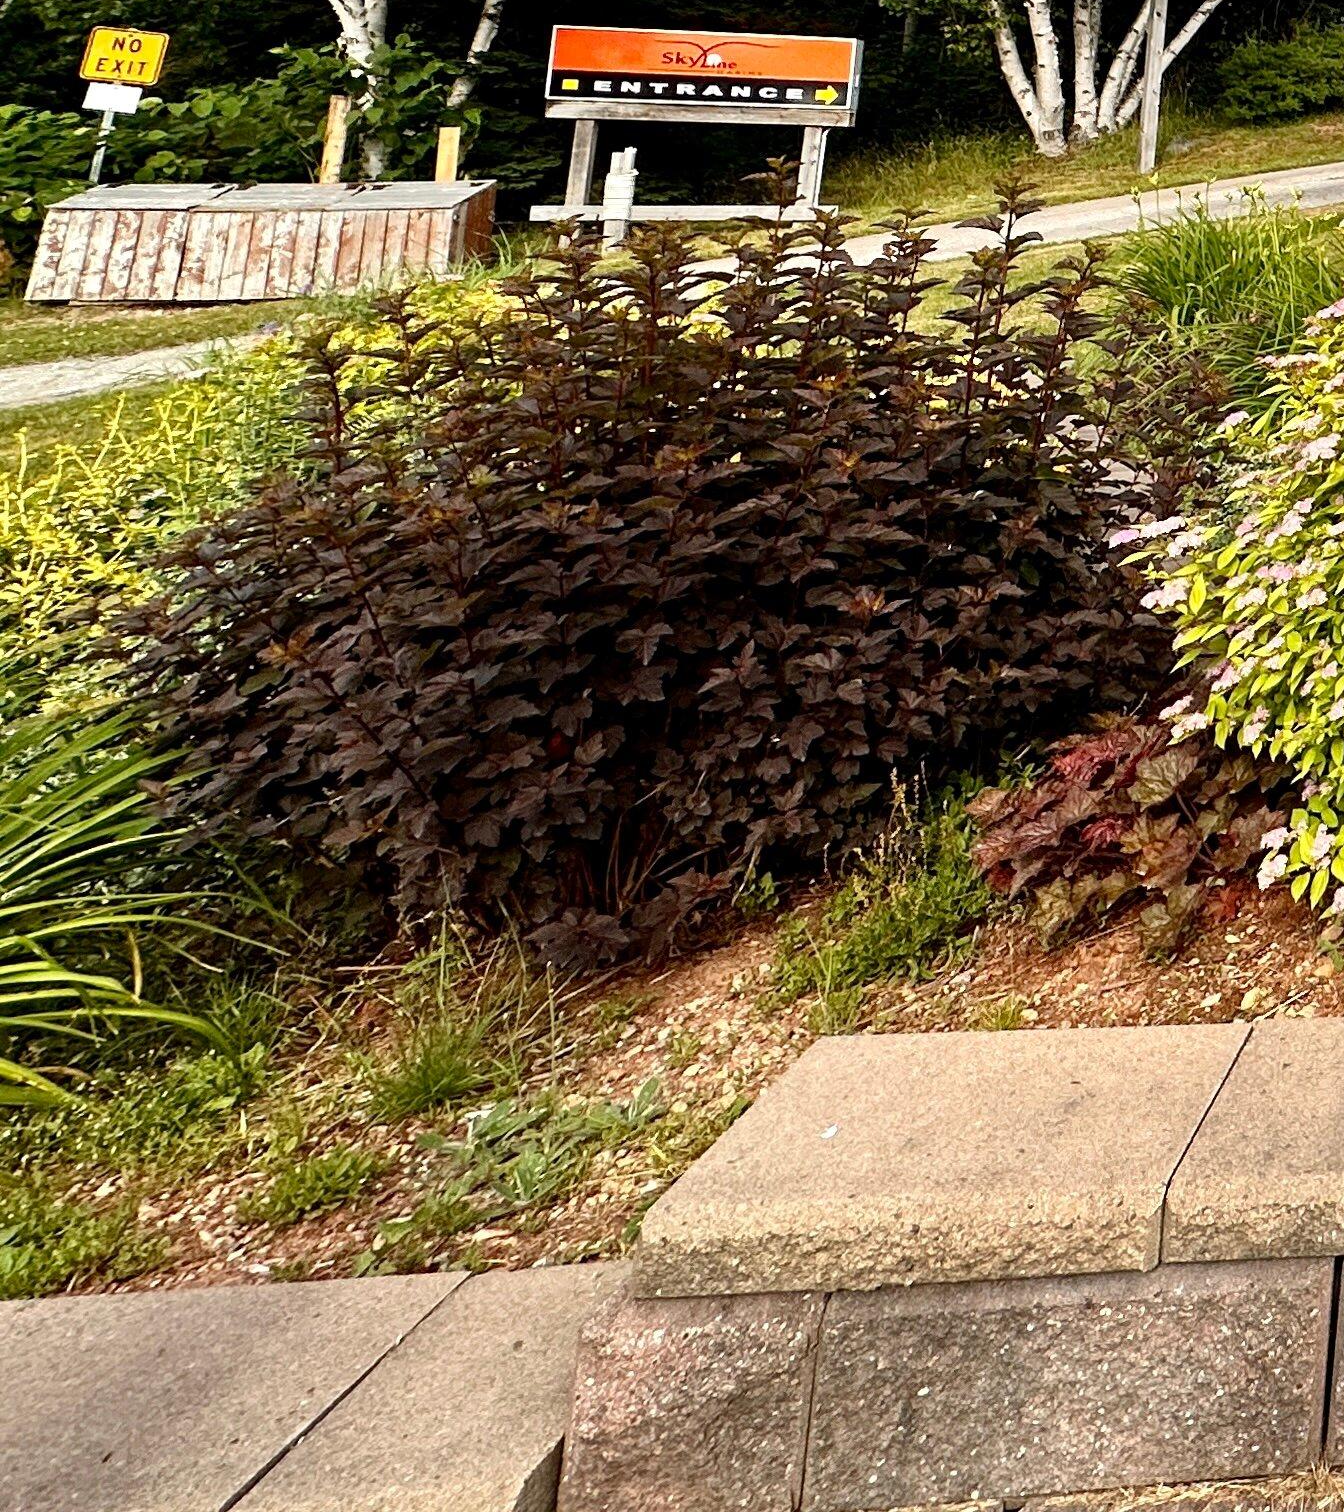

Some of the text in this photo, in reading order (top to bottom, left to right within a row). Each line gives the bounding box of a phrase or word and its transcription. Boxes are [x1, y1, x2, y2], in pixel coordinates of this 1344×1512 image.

[111, 37, 143, 53] NO
[95, 57, 149, 76] EXIT
[593, 79, 804, 100] ENTRANCE
